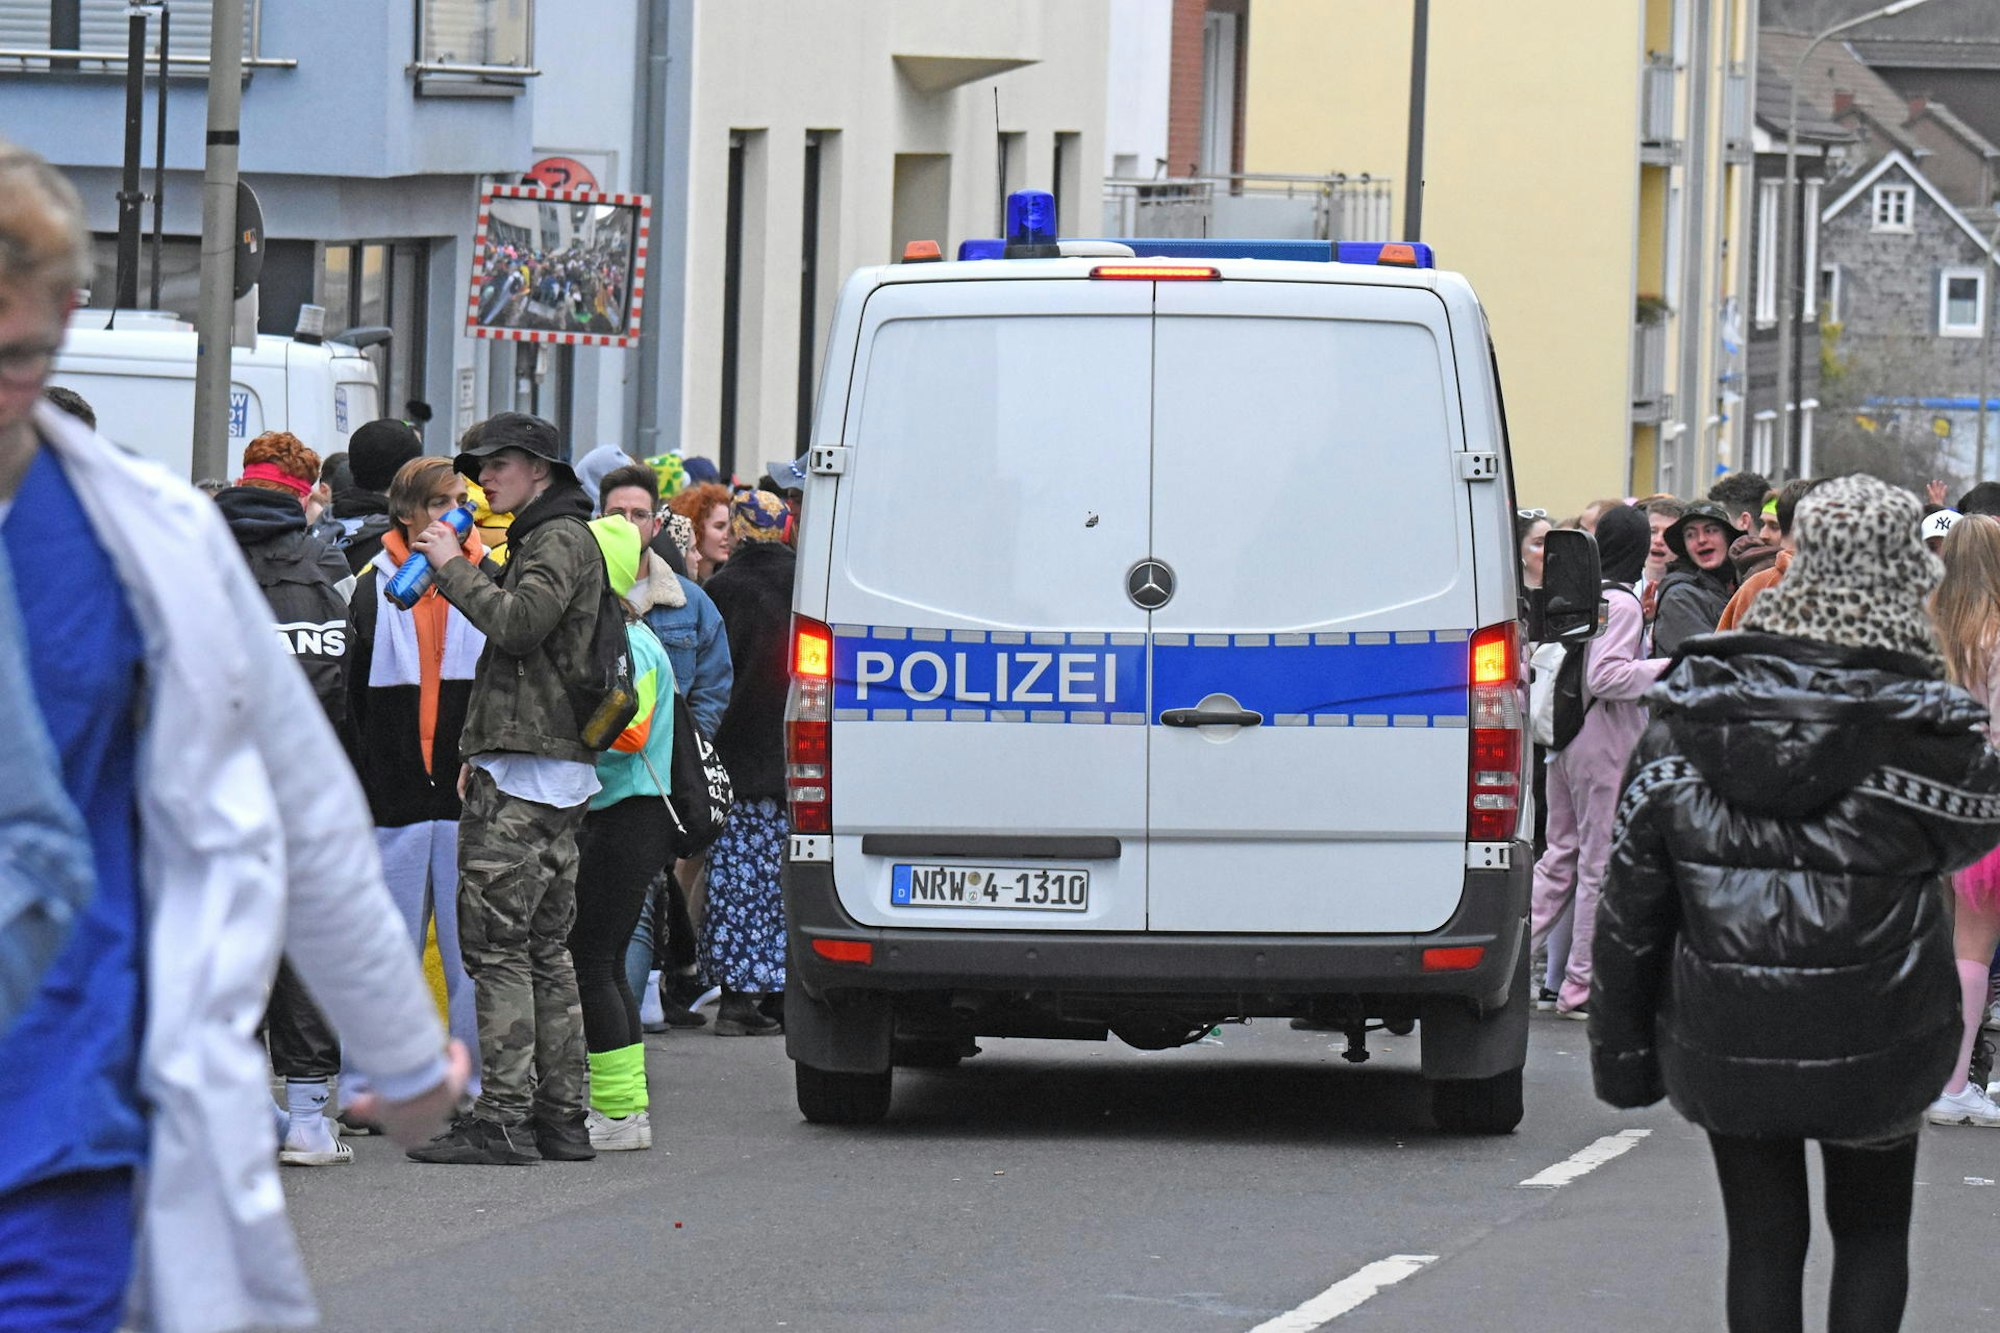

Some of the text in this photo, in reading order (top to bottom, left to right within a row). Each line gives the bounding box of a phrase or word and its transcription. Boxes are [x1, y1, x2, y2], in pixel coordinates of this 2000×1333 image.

[856, 651, 1116, 702] POLIZEI
[897, 869, 1085, 905] D NRW 4-1310
